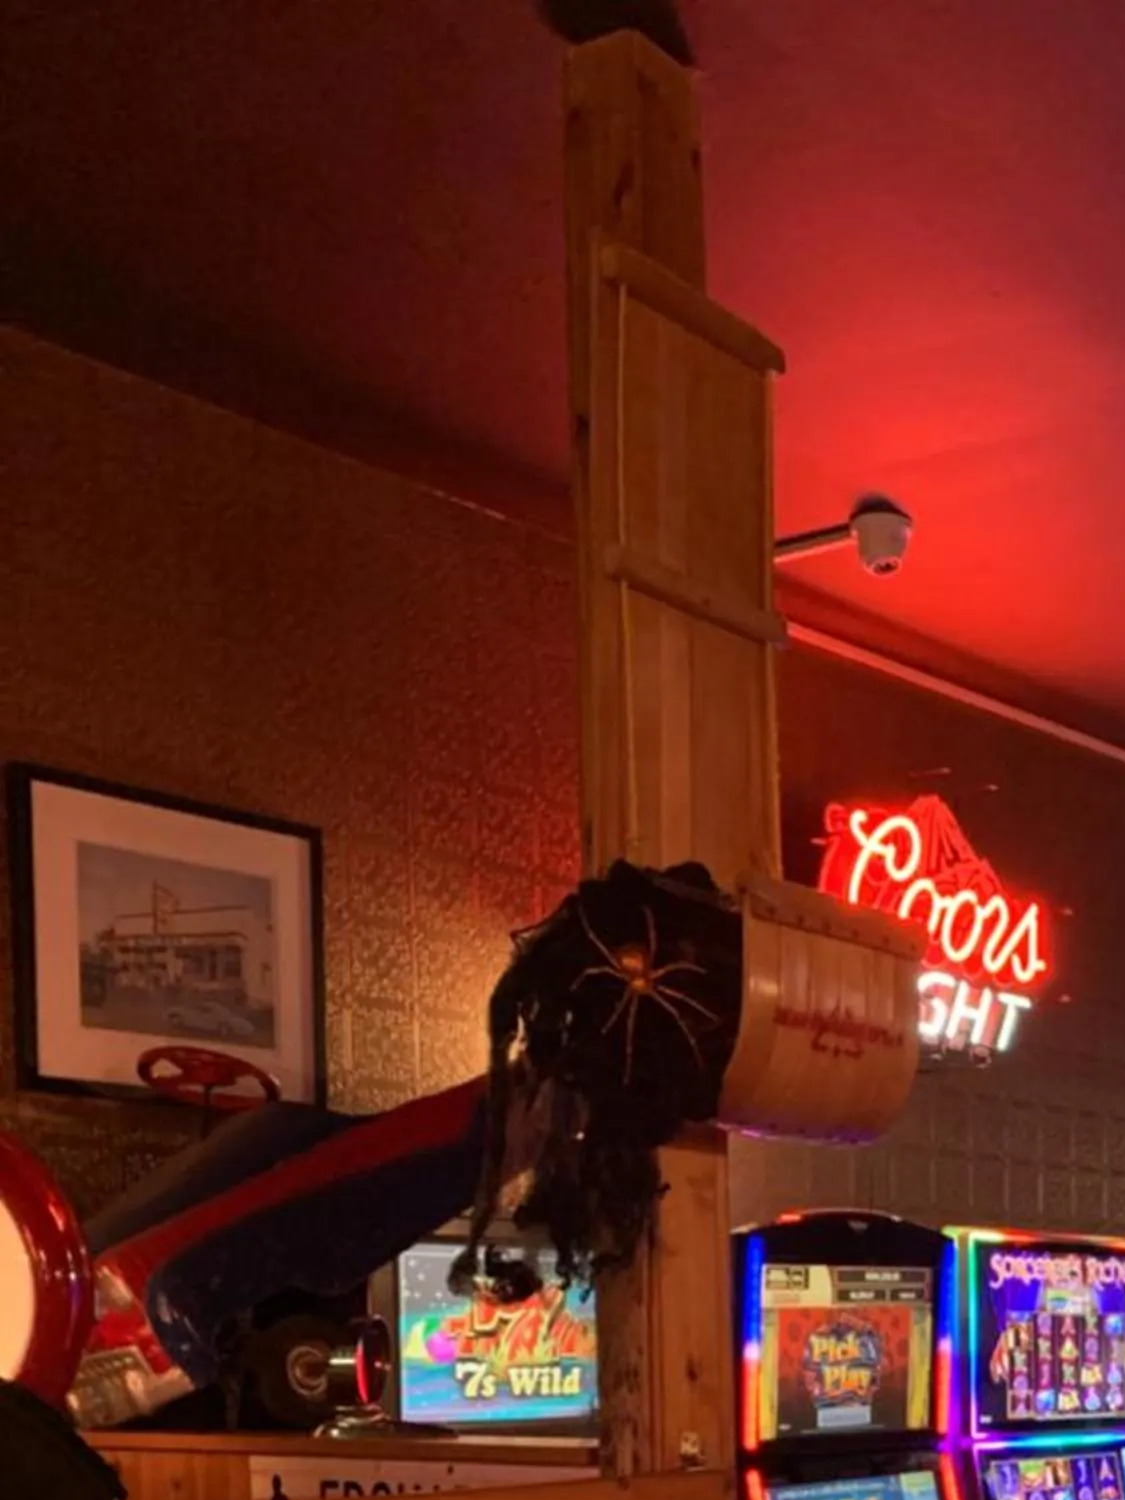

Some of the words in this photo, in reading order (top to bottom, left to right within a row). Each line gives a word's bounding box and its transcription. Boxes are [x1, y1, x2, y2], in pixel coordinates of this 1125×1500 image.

[849, 808, 1047, 984] Coors
[917, 969, 1032, 1053] GHT
[809, 1331, 861, 1363] Pick
[455, 1361, 496, 1398] 7s
[508, 1366, 582, 1397] Wild
[821, 1364, 872, 1397] Play
